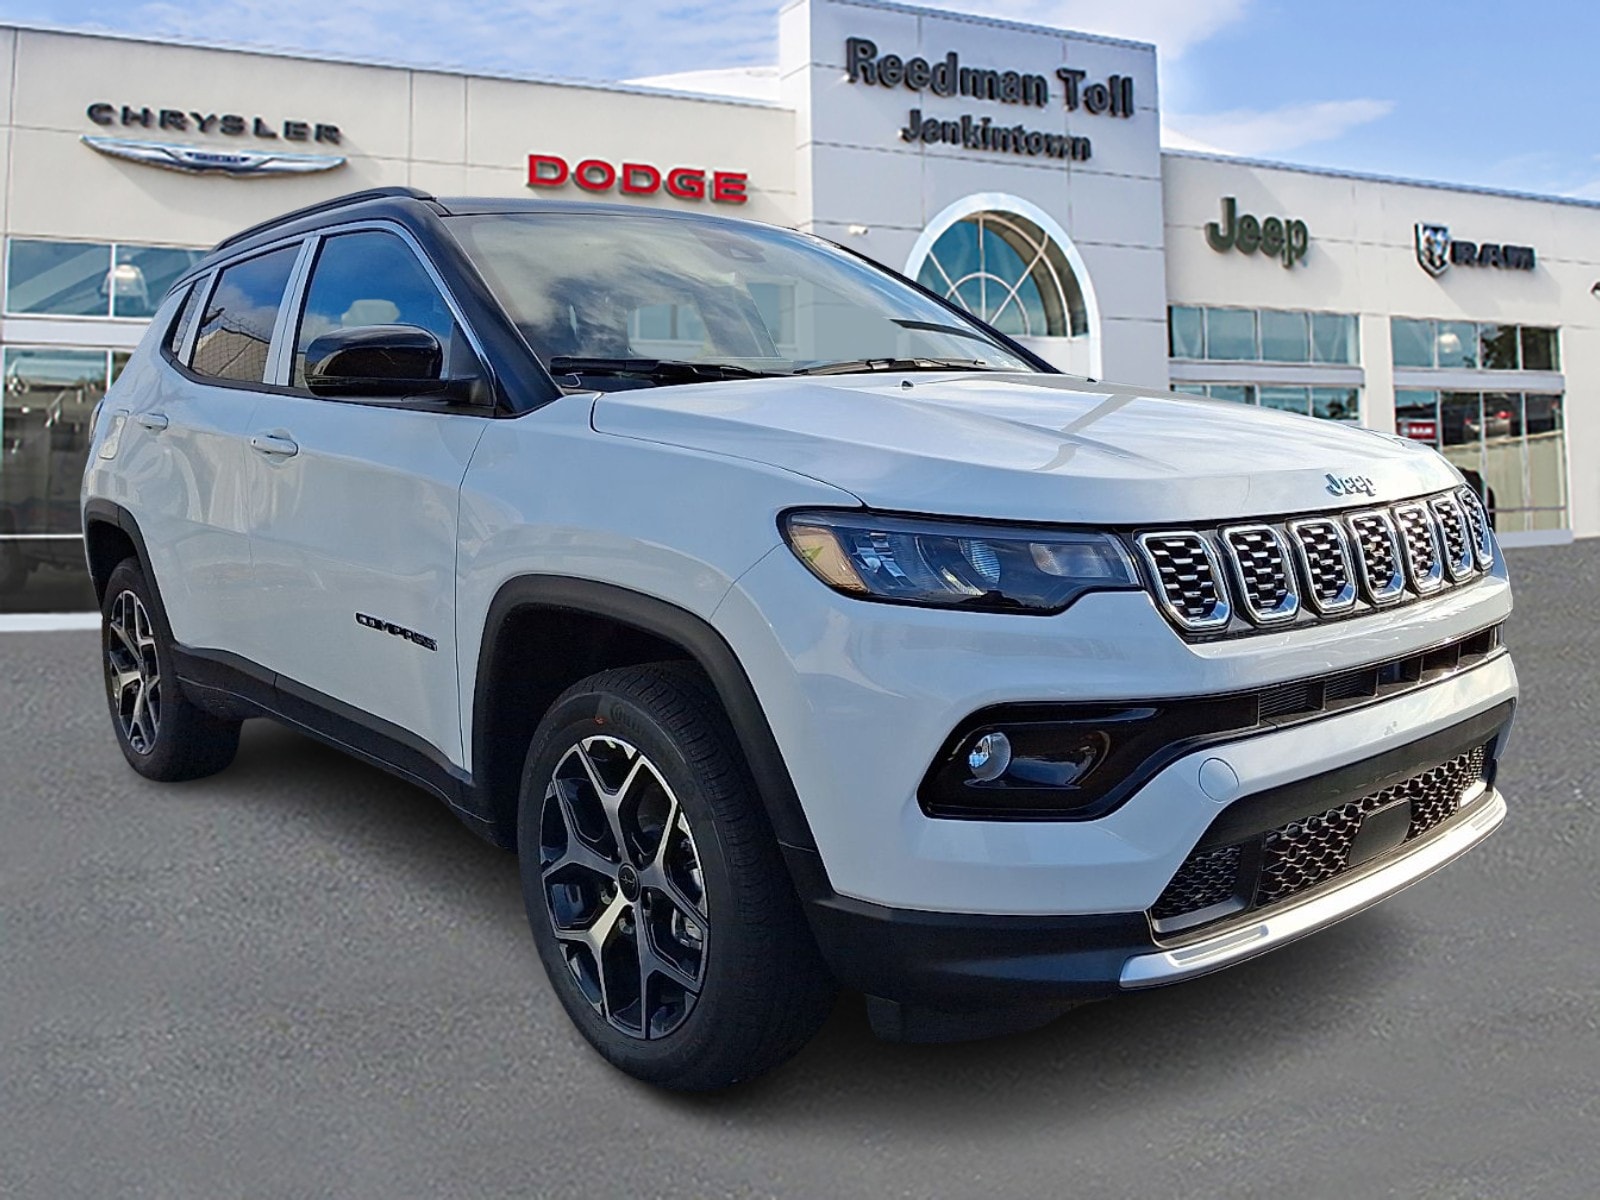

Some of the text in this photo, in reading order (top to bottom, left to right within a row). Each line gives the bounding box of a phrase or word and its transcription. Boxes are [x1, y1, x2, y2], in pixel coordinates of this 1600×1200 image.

[846, 36, 1135, 119] Reedman Toll
[86, 102, 342, 145] CHRYSLER
[901, 109, 1092, 162] Jenkintown
[527, 154, 748, 203] DODGE
[1205, 197, 1308, 270] Jeep
[1450, 241, 1536, 270] RAM
[1324, 473, 1377, 498] Jeep
[355, 612, 438, 652] COMPASS
